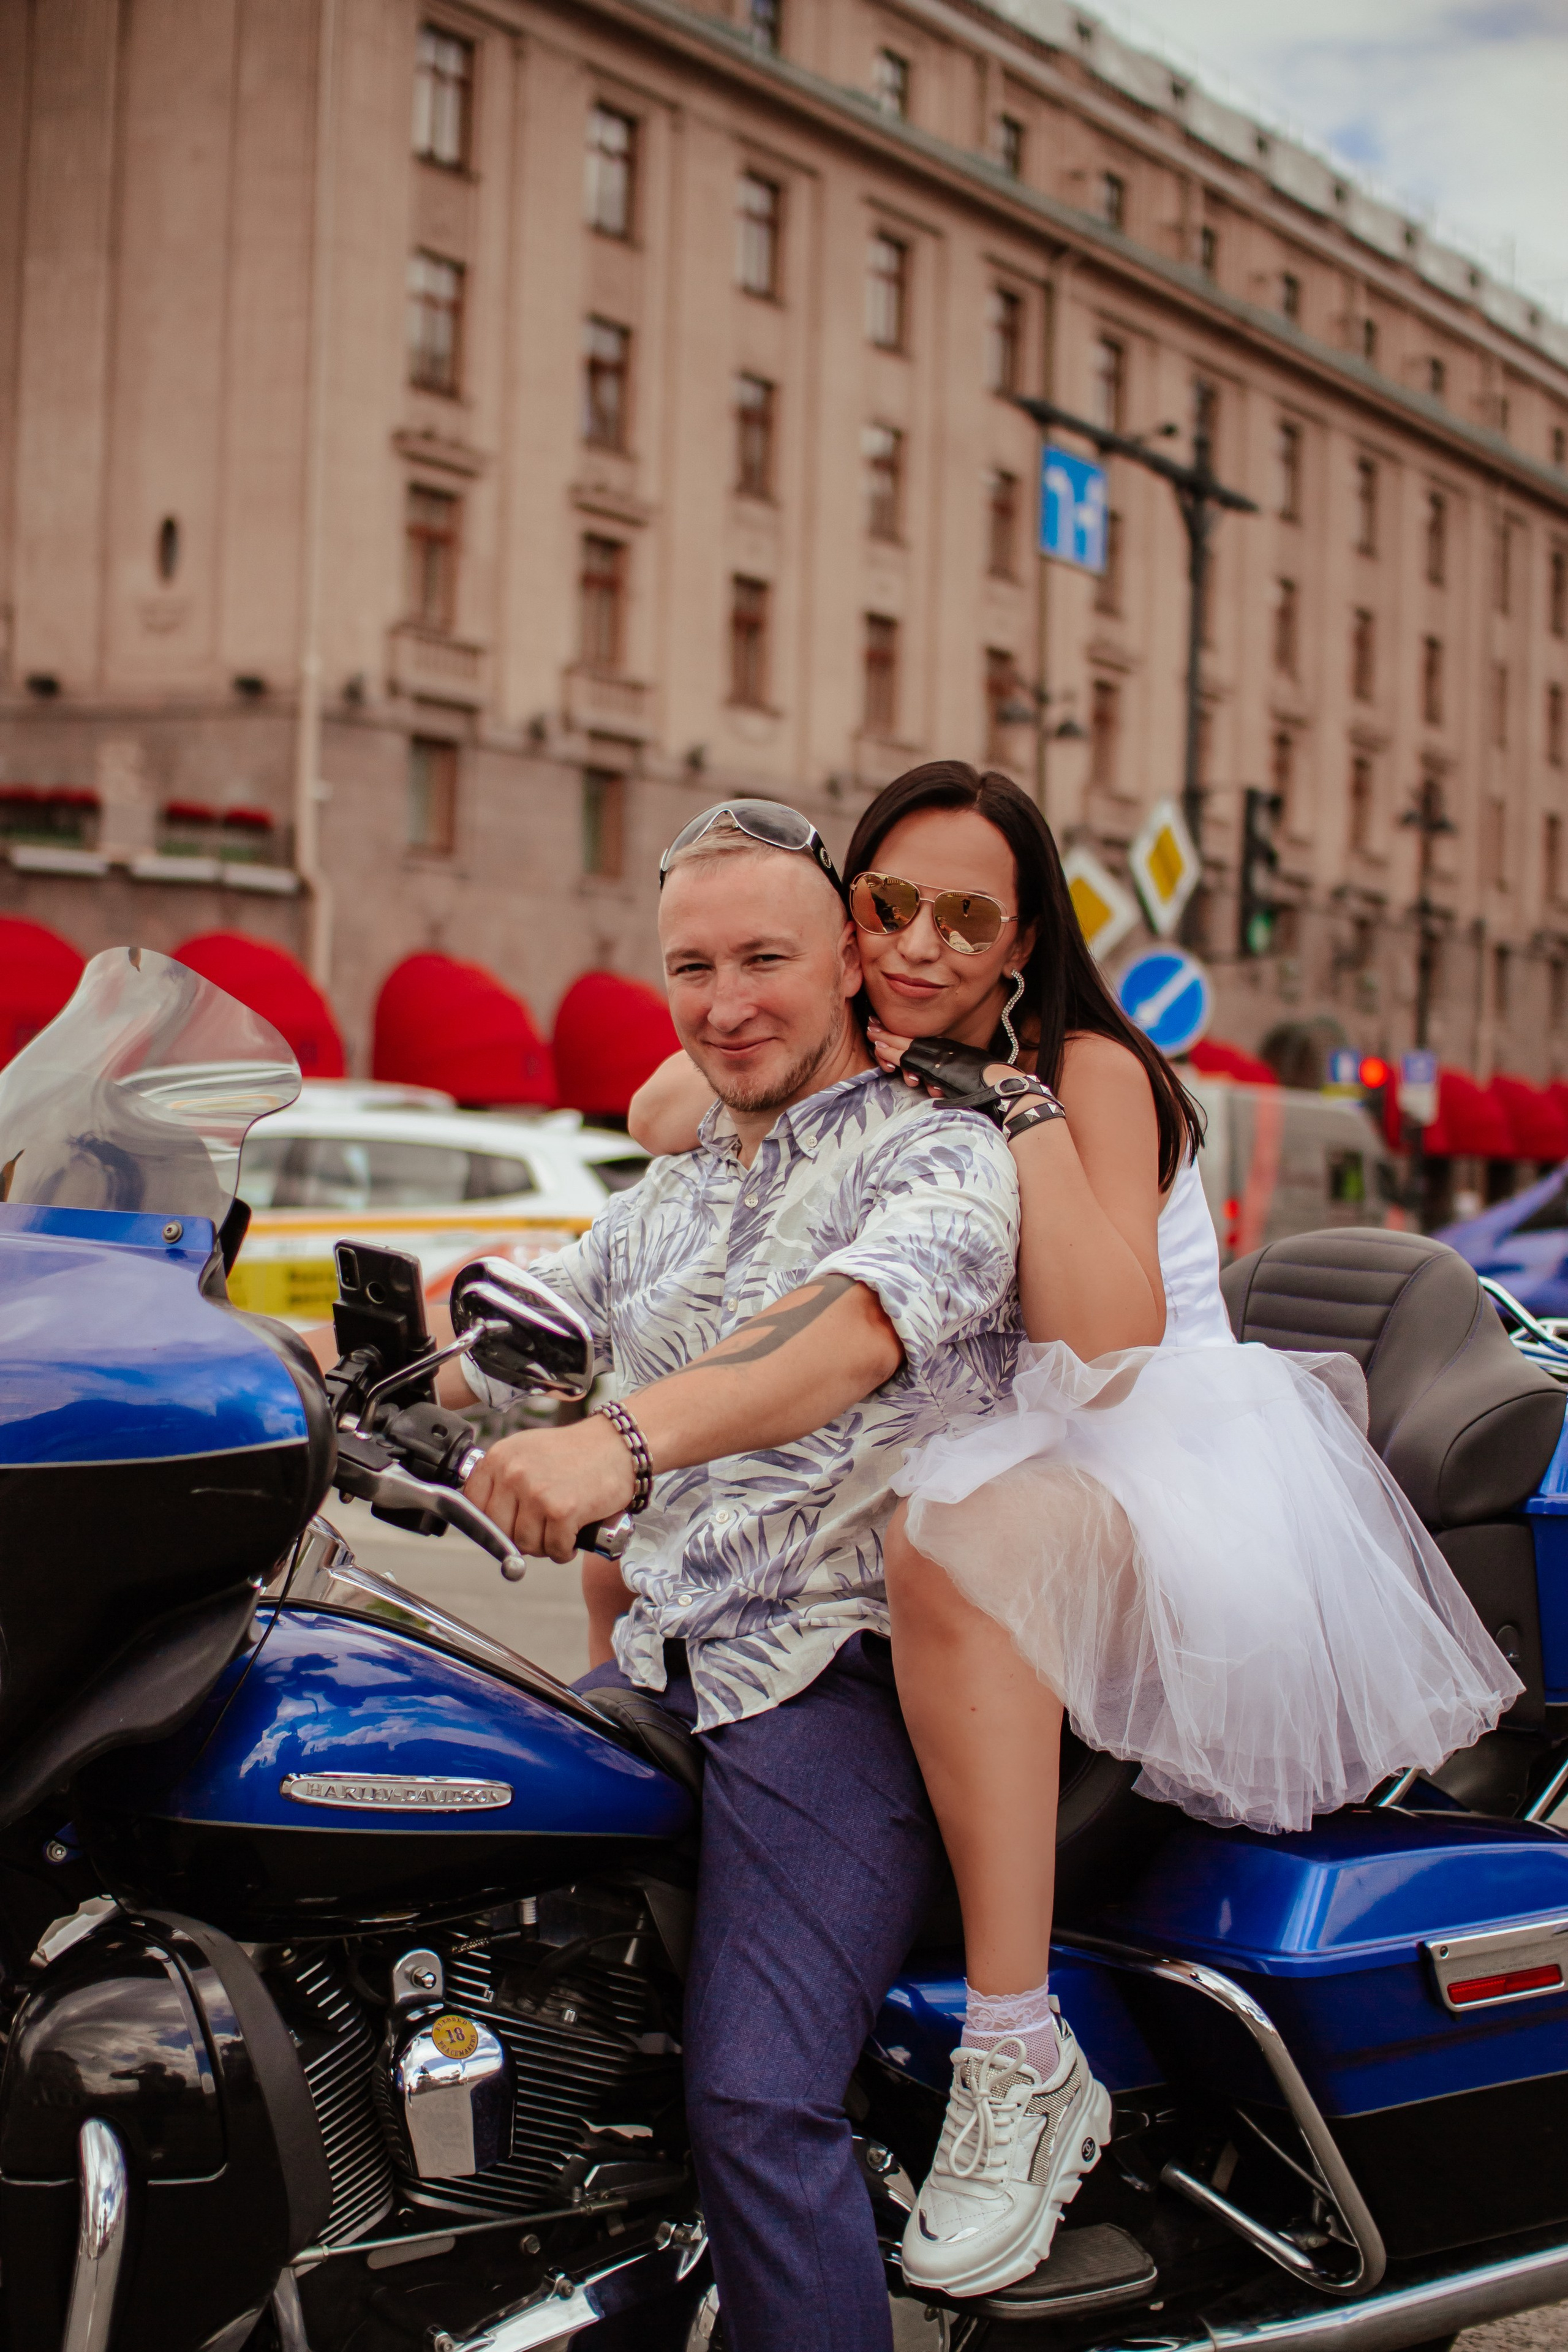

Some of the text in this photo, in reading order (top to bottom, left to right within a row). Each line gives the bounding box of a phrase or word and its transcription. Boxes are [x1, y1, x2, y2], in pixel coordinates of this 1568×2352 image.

[306, 1782, 501, 1803] HARLEY-DAVIDSON
[435, 2016, 468, 2032] BLESSED
[437, 2034, 476, 2056] PEACEMAKERS
[445, 2027, 466, 2044] 18
